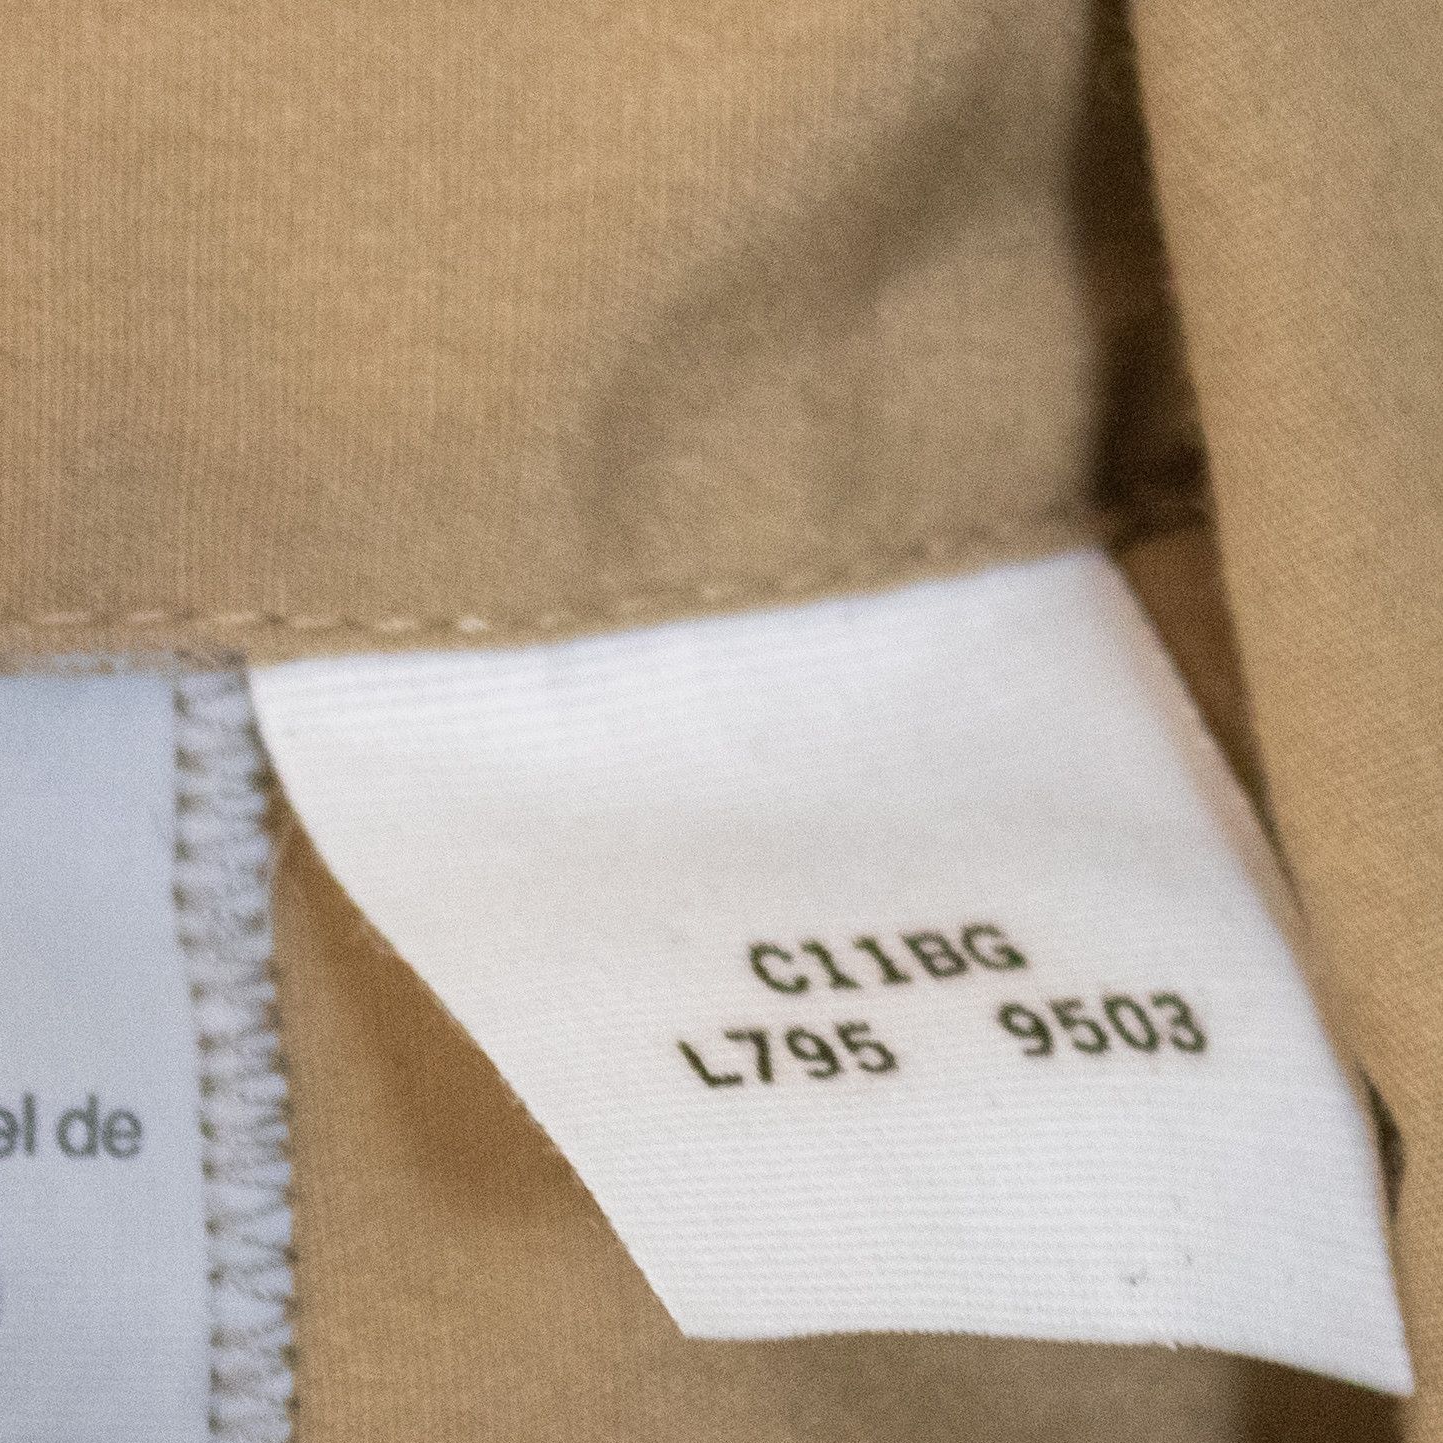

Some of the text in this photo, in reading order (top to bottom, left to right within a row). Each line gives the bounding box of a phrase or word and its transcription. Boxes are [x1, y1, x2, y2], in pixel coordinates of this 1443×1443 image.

[748, 920, 1028, 996] C11BG
[676, 992, 1209, 1090] L795 9503
[56, 1093, 144, 1159] de
